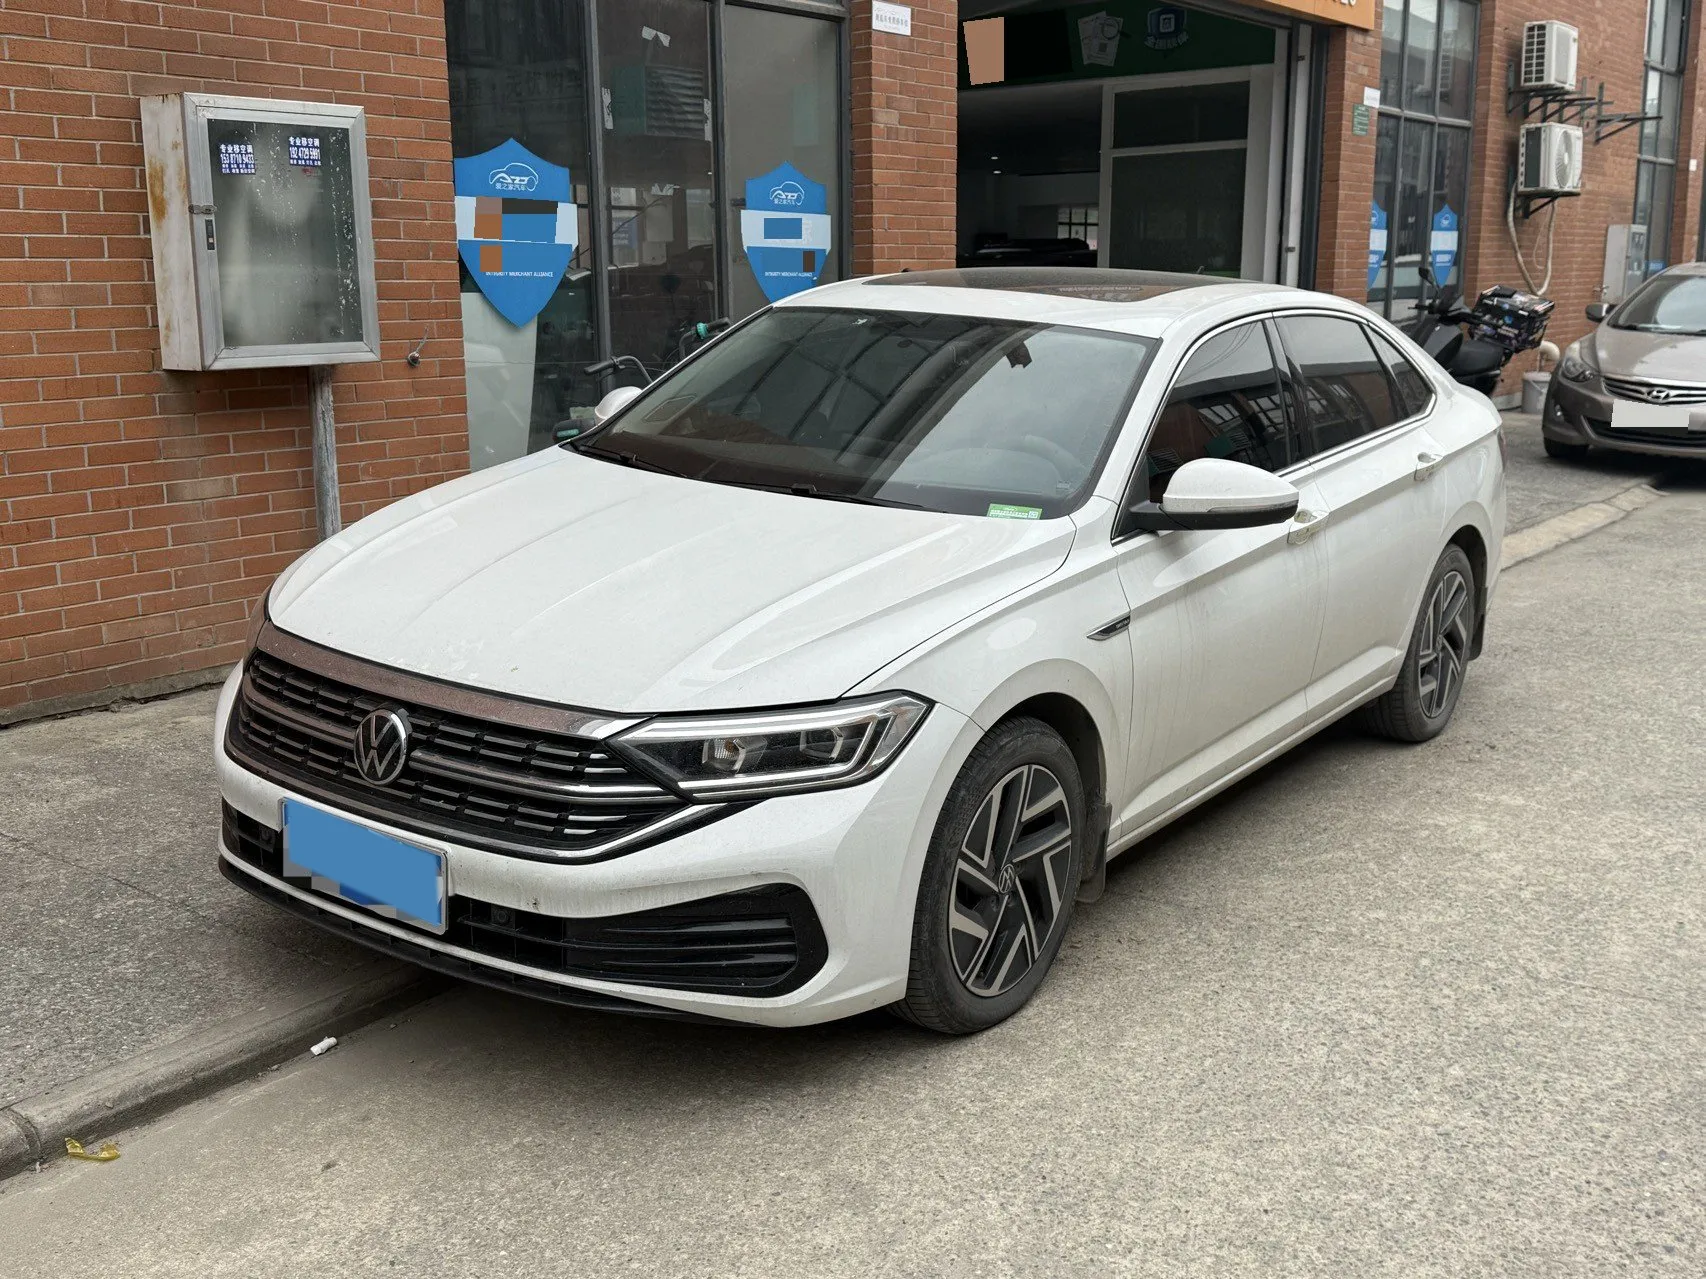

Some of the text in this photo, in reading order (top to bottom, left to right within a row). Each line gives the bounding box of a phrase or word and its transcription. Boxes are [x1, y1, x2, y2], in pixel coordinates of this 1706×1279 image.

[289, 136, 320, 147] 专业移空调
[220, 144, 253, 153] 专业移空调
